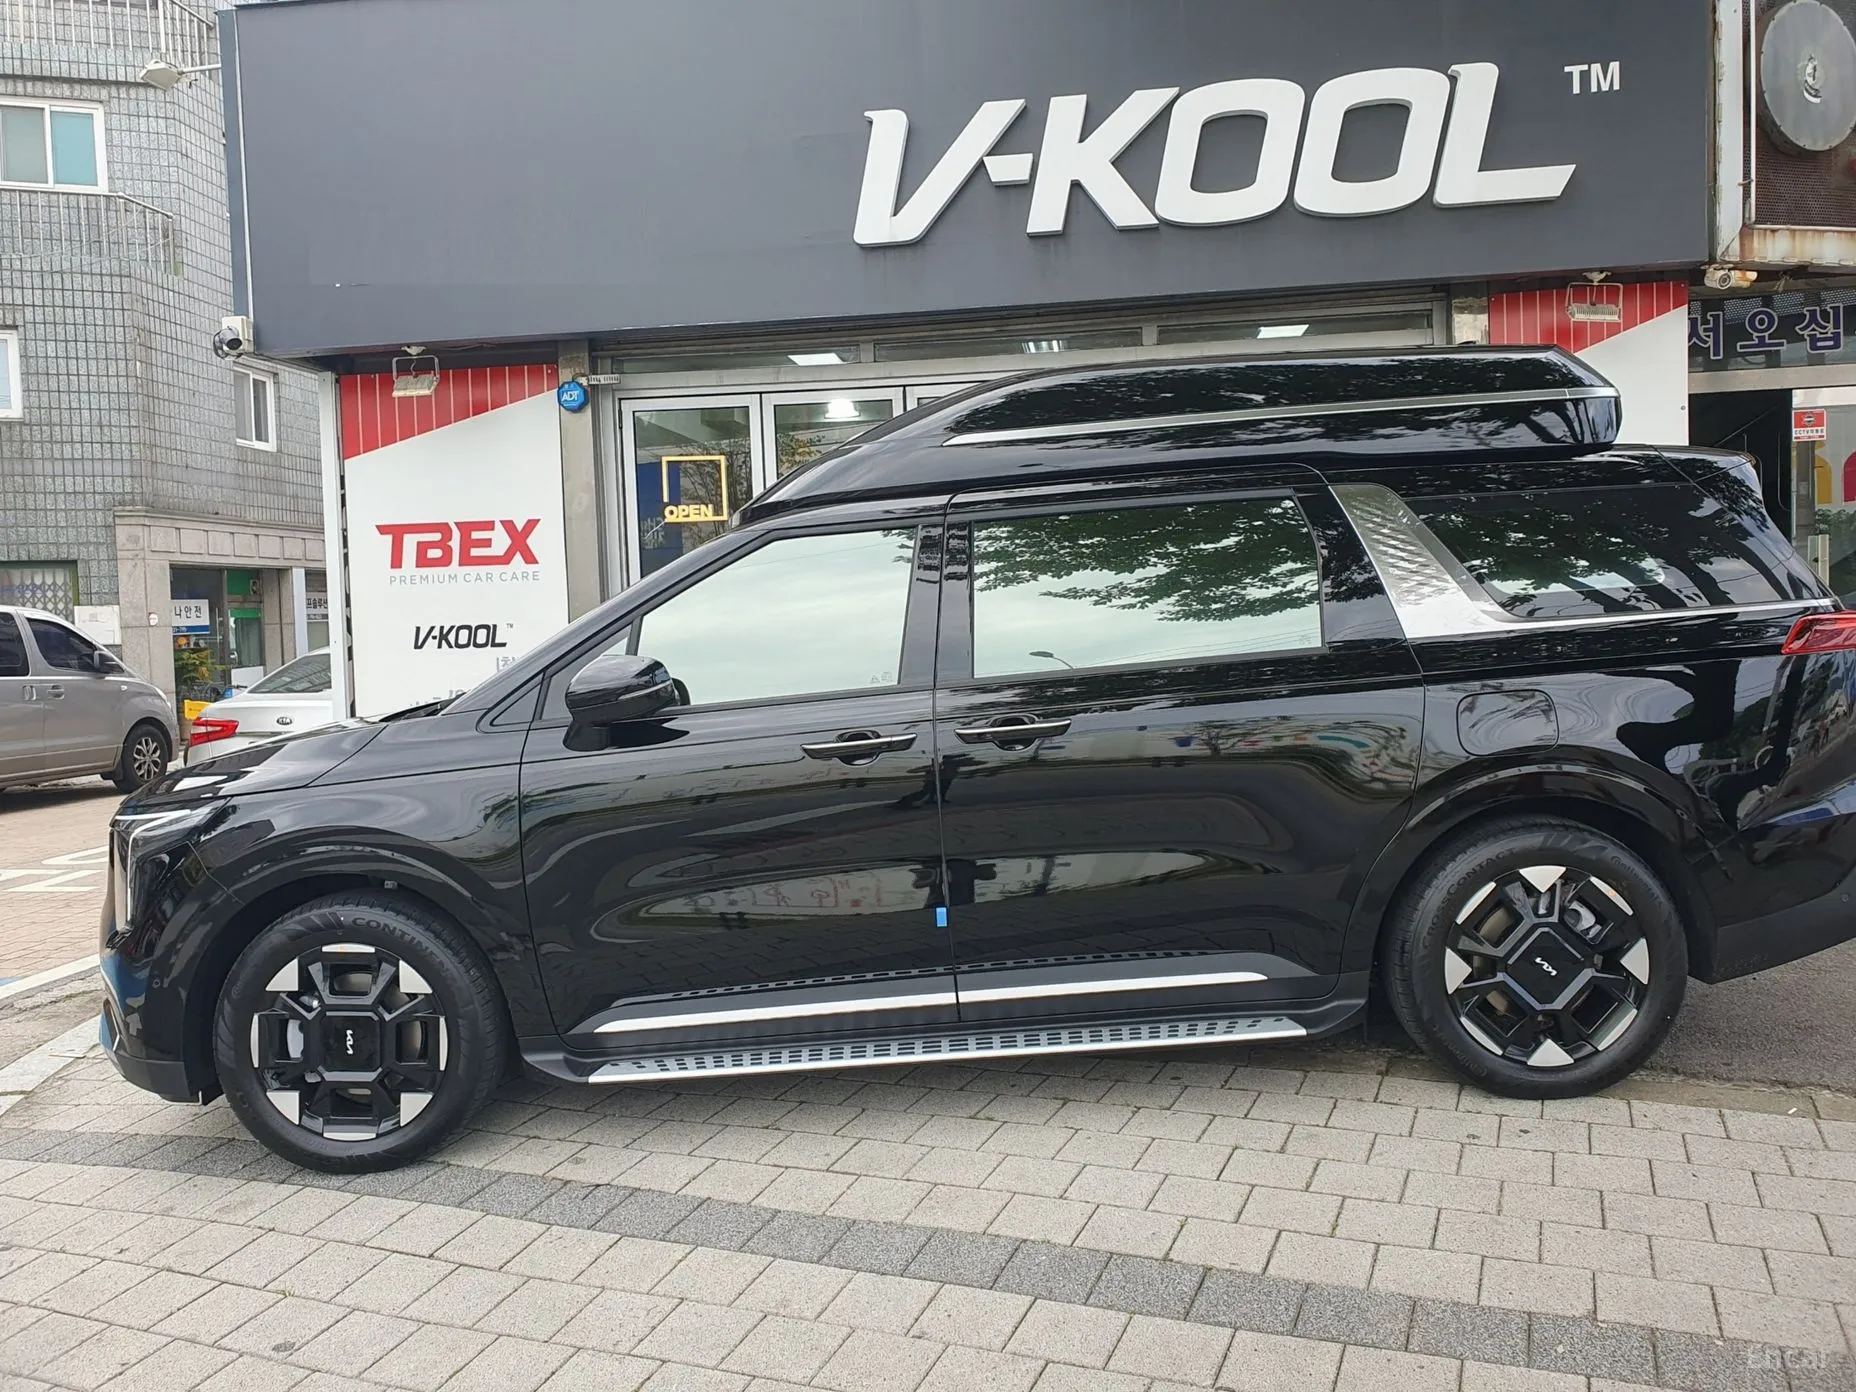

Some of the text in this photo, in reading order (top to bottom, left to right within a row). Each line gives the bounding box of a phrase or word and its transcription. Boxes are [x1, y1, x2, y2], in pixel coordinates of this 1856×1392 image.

[853, 62, 1577, 248] V-KOOL
[561, 391, 580, 402] ADT
[664, 503, 714, 519] OPEN
[375, 518, 541, 569] TBEX
[389, 570, 540, 585] PREMIUM CAR CARE
[413, 624, 507, 650] V-KOOL
